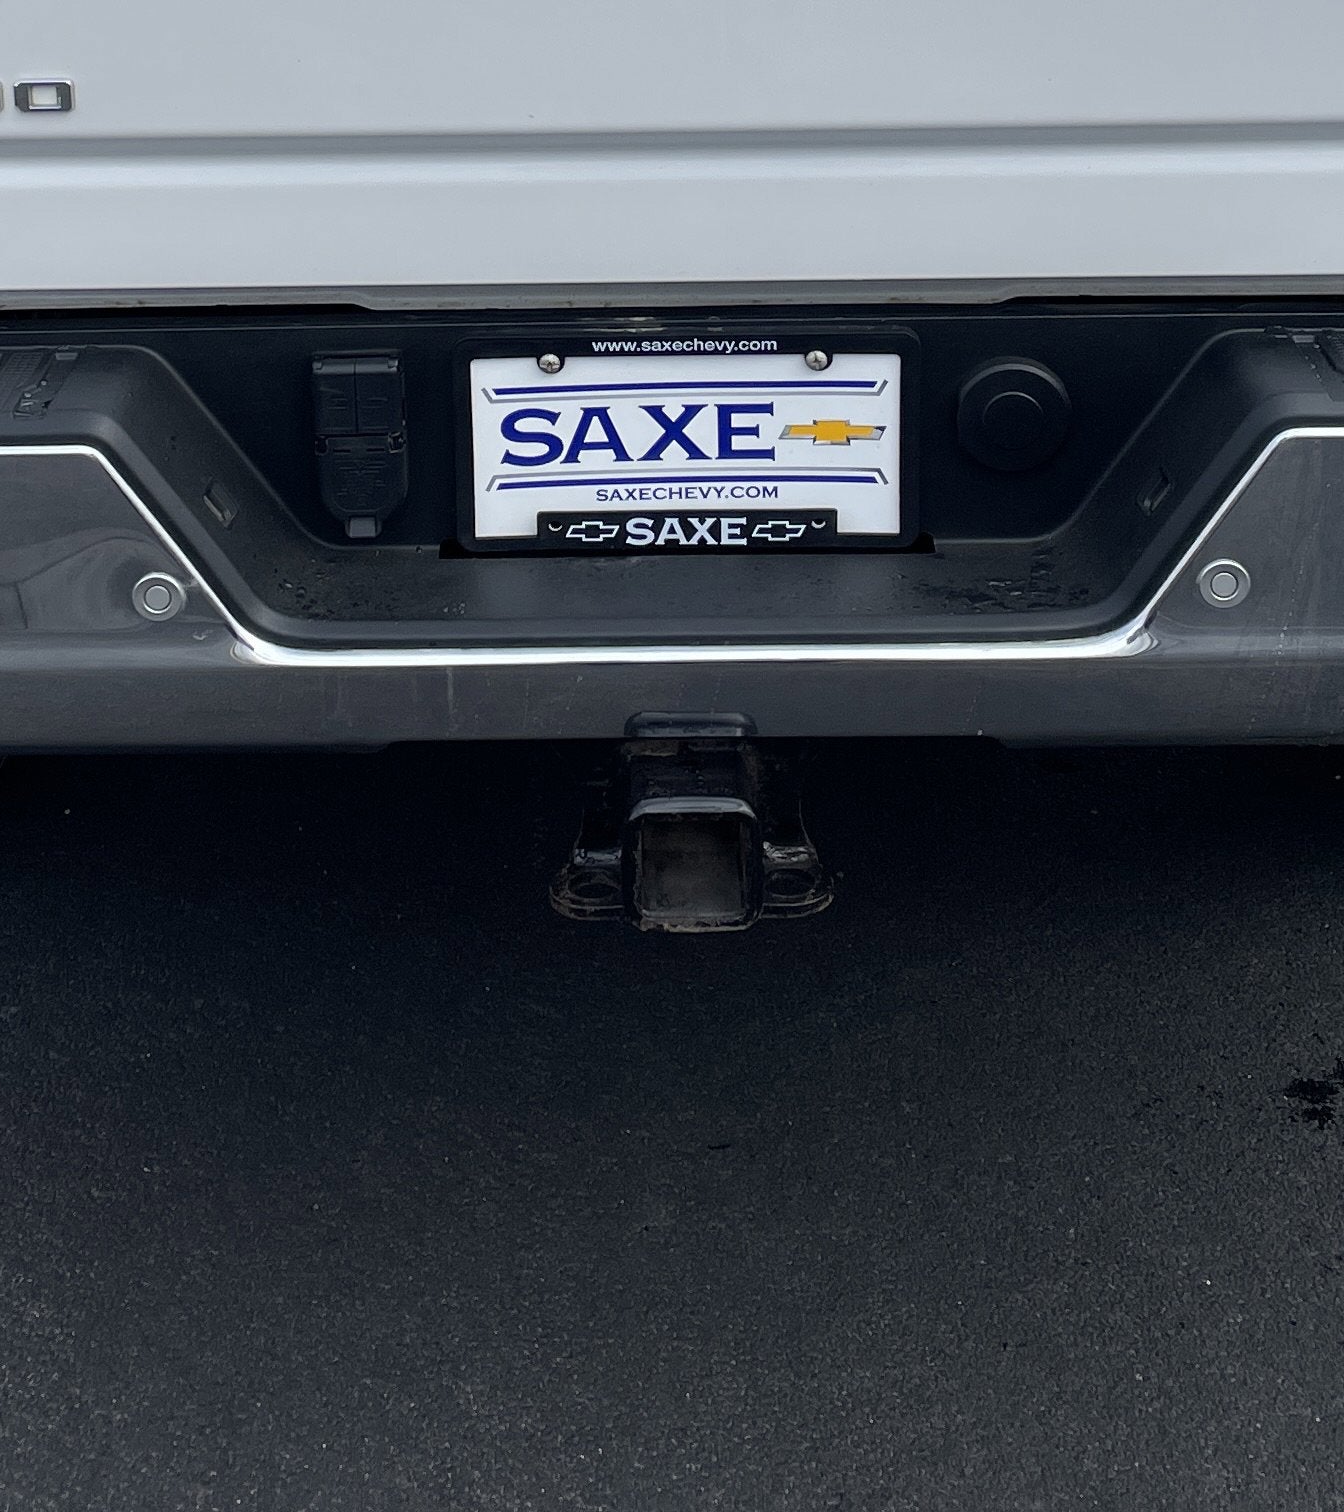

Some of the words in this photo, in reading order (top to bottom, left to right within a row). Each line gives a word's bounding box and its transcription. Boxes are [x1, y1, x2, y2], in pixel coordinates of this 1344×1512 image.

[591, 338, 778, 354] www.saxechevy.com
[499, 401, 776, 467] SAXE
[595, 485, 779, 502] SAXECHEVY.COM
[625, 516, 748, 546] SAXE
